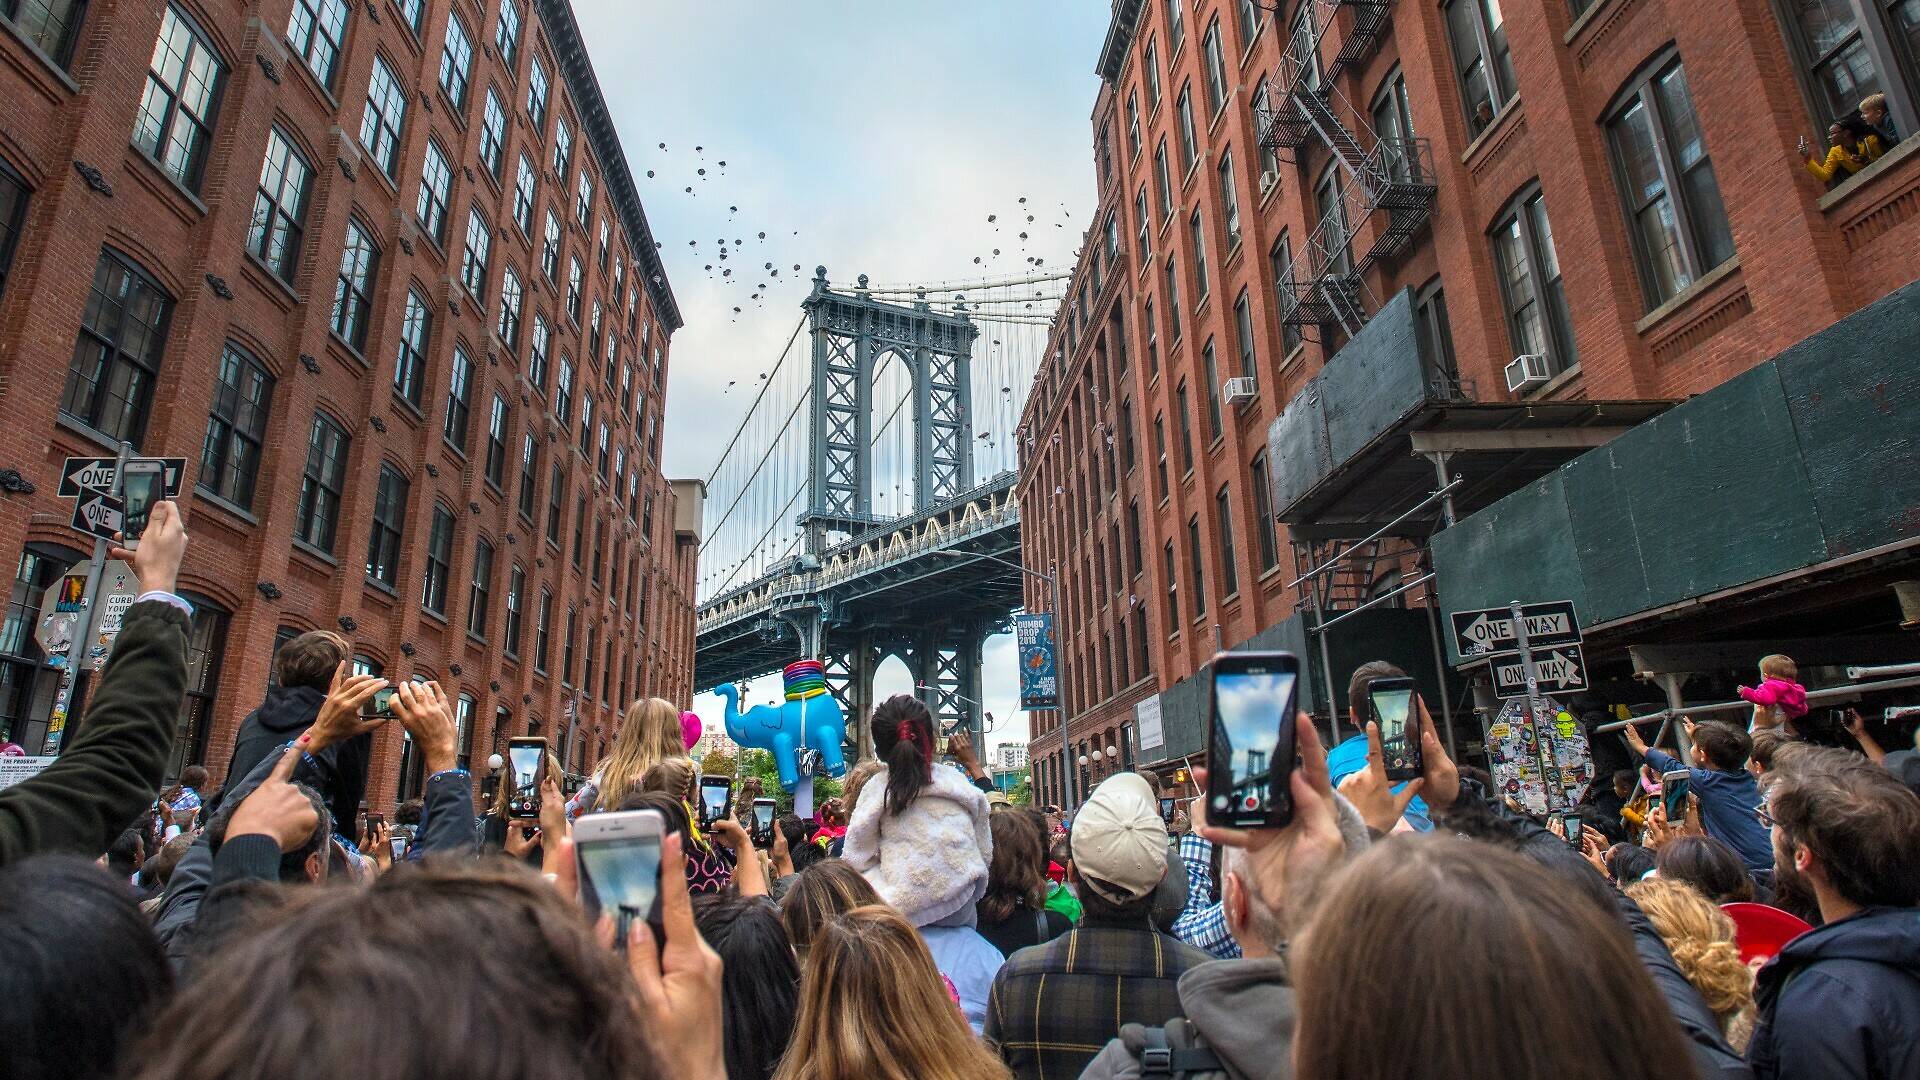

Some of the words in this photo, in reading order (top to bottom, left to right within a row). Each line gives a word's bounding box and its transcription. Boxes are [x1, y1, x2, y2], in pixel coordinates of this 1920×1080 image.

[81, 470, 113, 485] ONE
[88, 504, 112, 526] ONE
[109, 596, 132, 604] CURB
[1017, 620, 1044, 628] DUMBO
[1474, 621, 1510, 640] ONE
[1524, 615, 1560, 635] WAY
[1018, 628, 1040, 637] DROP
[1019, 636, 1037, 645] 2018
[1540, 661, 1567, 680] WAY
